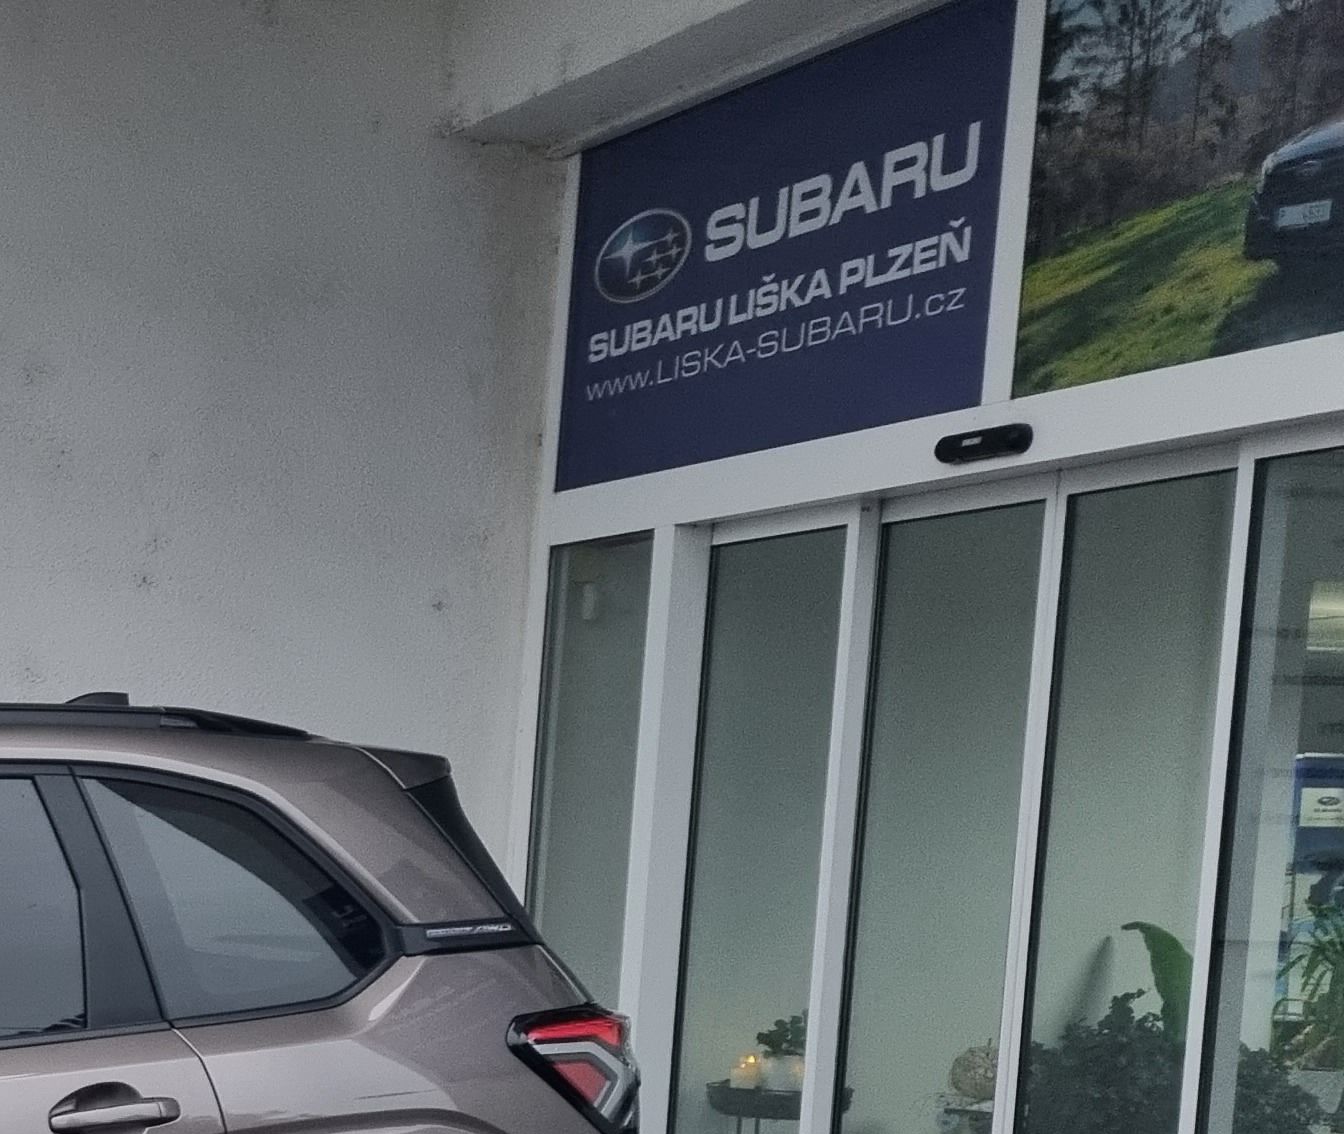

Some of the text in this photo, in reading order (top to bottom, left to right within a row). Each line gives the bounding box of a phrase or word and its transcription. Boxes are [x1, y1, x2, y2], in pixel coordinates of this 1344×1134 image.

[704, 121, 983, 263] SUBARU
[585, 287, 968, 402] www.LISKA-SUBARU.cz
[588, 216, 973, 364] SUBARU LIŠKA PLZEŇ
